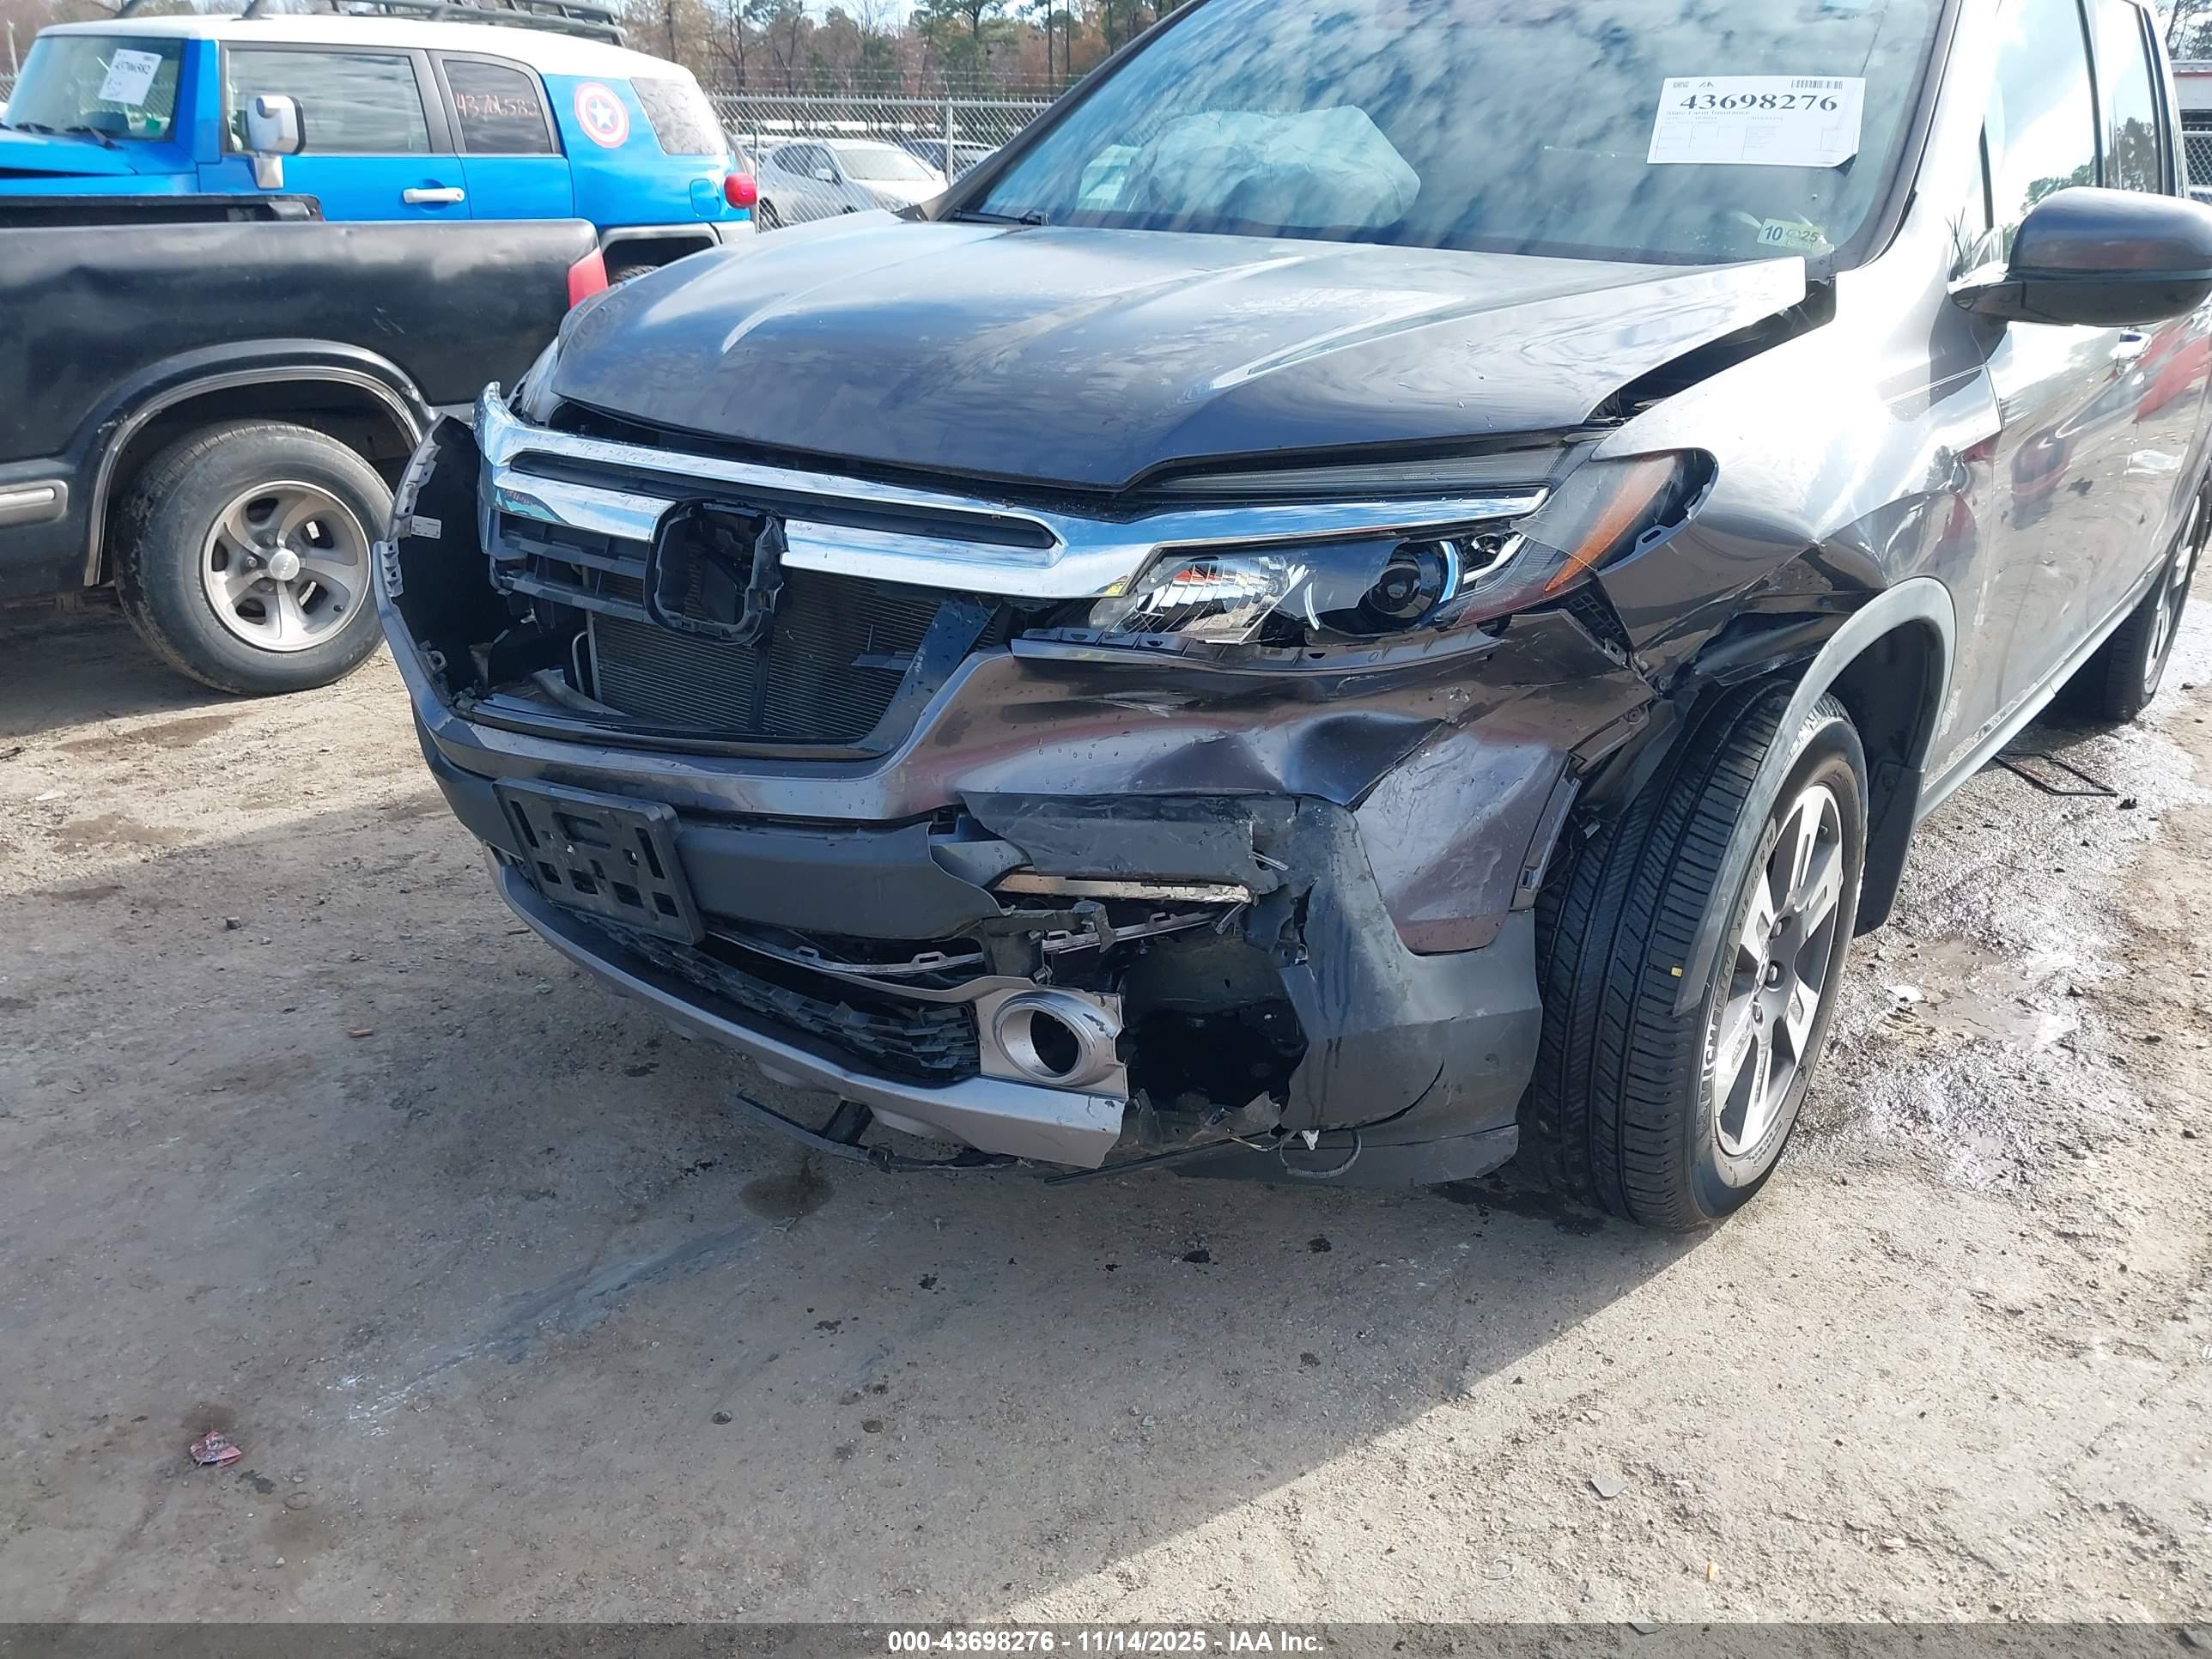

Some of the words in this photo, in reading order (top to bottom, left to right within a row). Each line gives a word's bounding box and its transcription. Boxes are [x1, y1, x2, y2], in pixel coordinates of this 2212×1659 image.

[1680, 94, 1838, 112] 43698276
[1765, 225, 1784, 241] 10
[1800, 230, 1820, 242] 25
[1700, 949, 1735, 1103] MICHELIN
